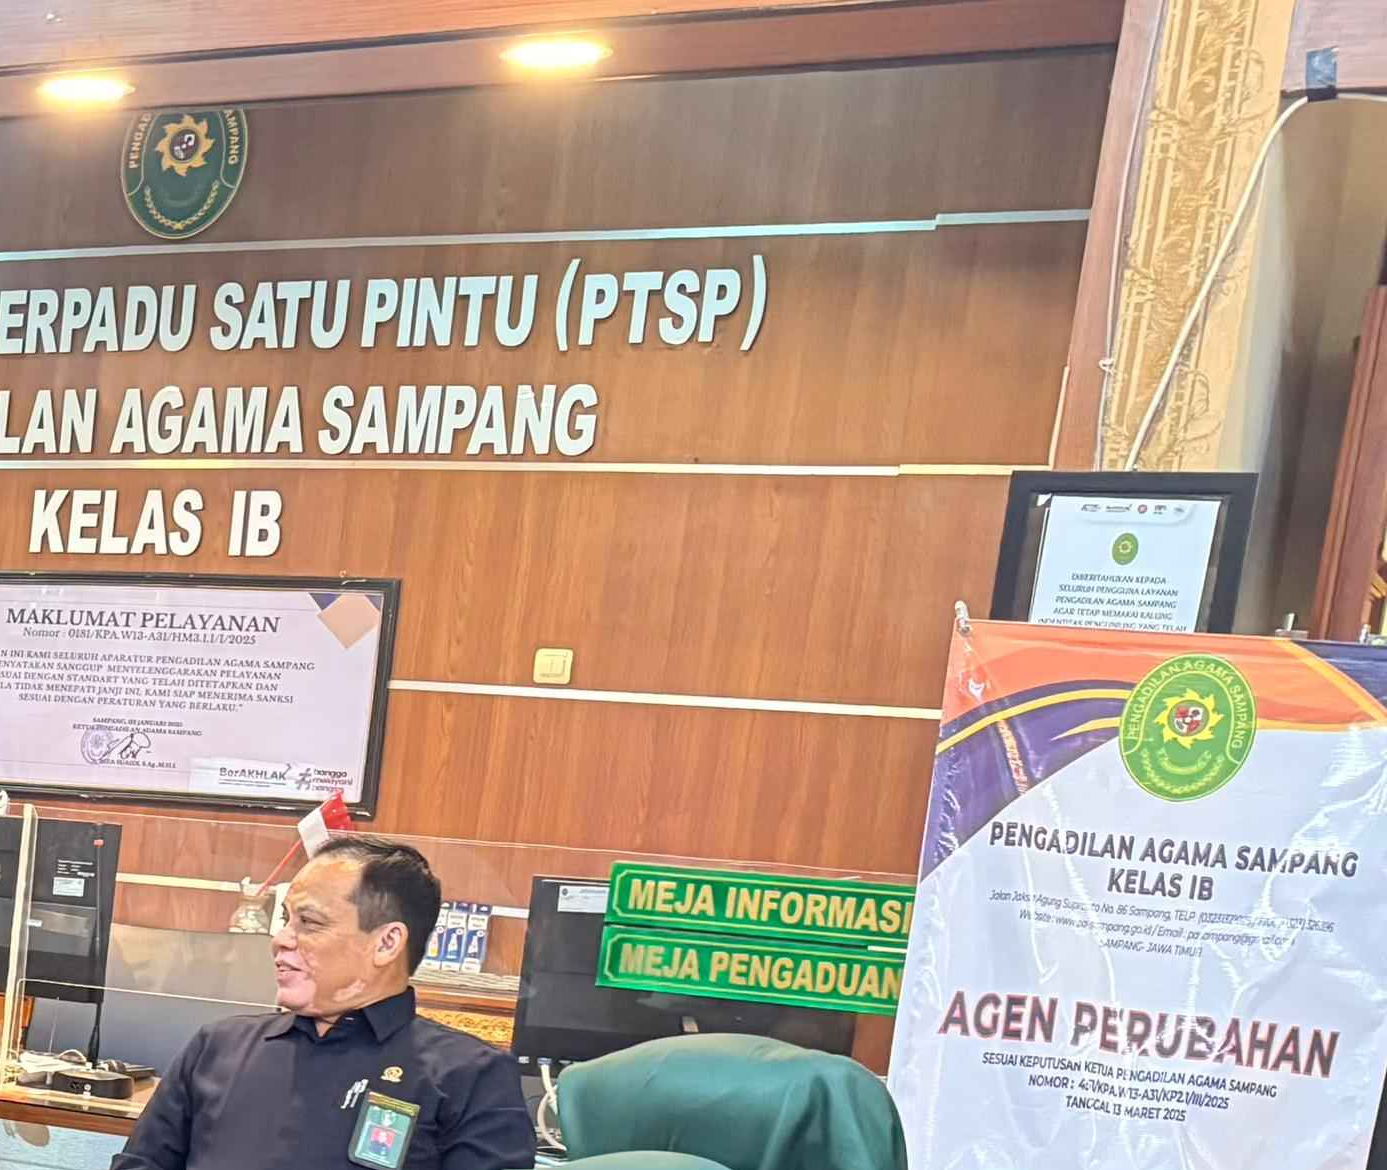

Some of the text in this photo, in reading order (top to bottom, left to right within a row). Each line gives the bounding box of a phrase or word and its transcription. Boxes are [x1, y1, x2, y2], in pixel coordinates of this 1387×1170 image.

[210, 279, 351, 351] SATU
[360, 274, 539, 348] PINTU
[555, 254, 768, 352] (PTSP)
[109, 384, 304, 456] AGAMA
[318, 383, 600, 457] SAMPANG
[28, 489, 283, 558] KELAS IB
[1106, 599, 1134, 607] AGAMA
[1137, 600, 1176, 609] SAMPANG
[1141, 589, 1178, 597] LAYANAN
[6, 608, 281, 632] MAKLUMAT PELAYANAN
[23, 627, 60, 638] Nomor
[27, 651, 50, 659] KAMI
[53, 652, 98, 661] SELURUH
[100, 654, 155, 664] APARATUR
[156, 656, 221, 666] PENGADILAN
[224, 659, 260, 668] AGAMA
[263, 661, 315, 670] SAMPANG
[56, 663, 103, 672] SANGGUP
[107, 665, 218, 677] MENYELENGGARAKAN
[220, 671, 282, 680] PELAYANAN
[24, 672, 64, 681] DENGAN
[122, 677, 151, 686] YANG
[152, 678, 185, 687] TELAH
[187, 680, 253, 690] DITETAPKAN
[255, 683, 278, 691] DAN
[46, 684, 95, 693] MENEPATI
[97, 687, 122, 695] JANJI
[145, 689, 170, 697] KAMI
[198, 692, 253, 701] MENERIMA
[256, 695, 293, 704] SANKSI
[19, 694, 51, 702] SESUAI
[54, 695, 94, 705] DENGAN
[97, 697, 156, 708] PERATURAN
[159, 700, 186, 709] YANG
[1127, 660, 1249, 749] PENGADILAN AGAMA SAMPANG
[988, 820, 1359, 879] PENGADILAN AGAMA SAMPANG
[1107, 868, 1214, 901] KELAS IB
[628, 879, 716, 918] MEJA
[1146, 943, 1173, 954] JAWA
[619, 943, 901, 1000] MEJA PENGADUAN
[938, 990, 1341, 1079] AGEN PERUBAHAN
[982, 1052, 1017, 1066] SESUAI
[1019, 1056, 1081, 1072] KEPUTUSAN
[1084, 1061, 1113, 1076] KETUA
[1187, 1074, 1227, 1090] AGAMA
[1228, 1080, 1277, 1098] SAMPANG
[1028, 1074, 1068, 1089] NOMOR
[1066, 1095, 1186, 1122] TANGGAL 13 MARET 2025
